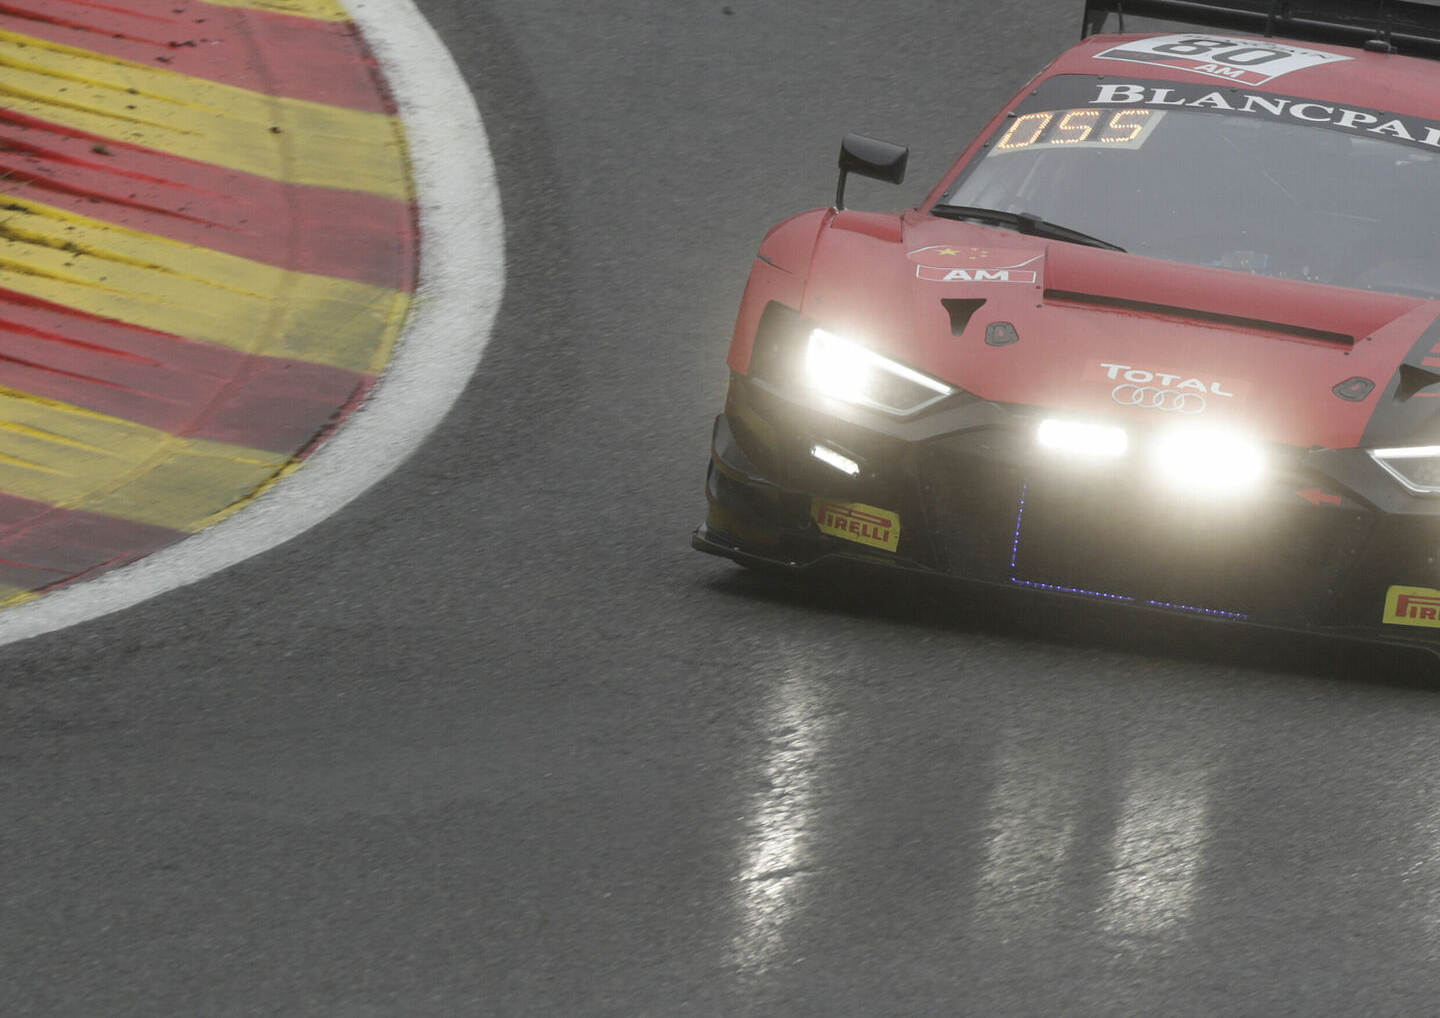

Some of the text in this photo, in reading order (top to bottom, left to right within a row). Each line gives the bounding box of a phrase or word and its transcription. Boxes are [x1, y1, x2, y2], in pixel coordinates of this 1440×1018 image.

[1150, 38, 1294, 67] 80
[1194, 62, 1246, 79] AM
[942, 269, 1009, 282] AM
[1100, 362, 1233, 397] TOTAL
[817, 501, 893, 543] PIRELLI
